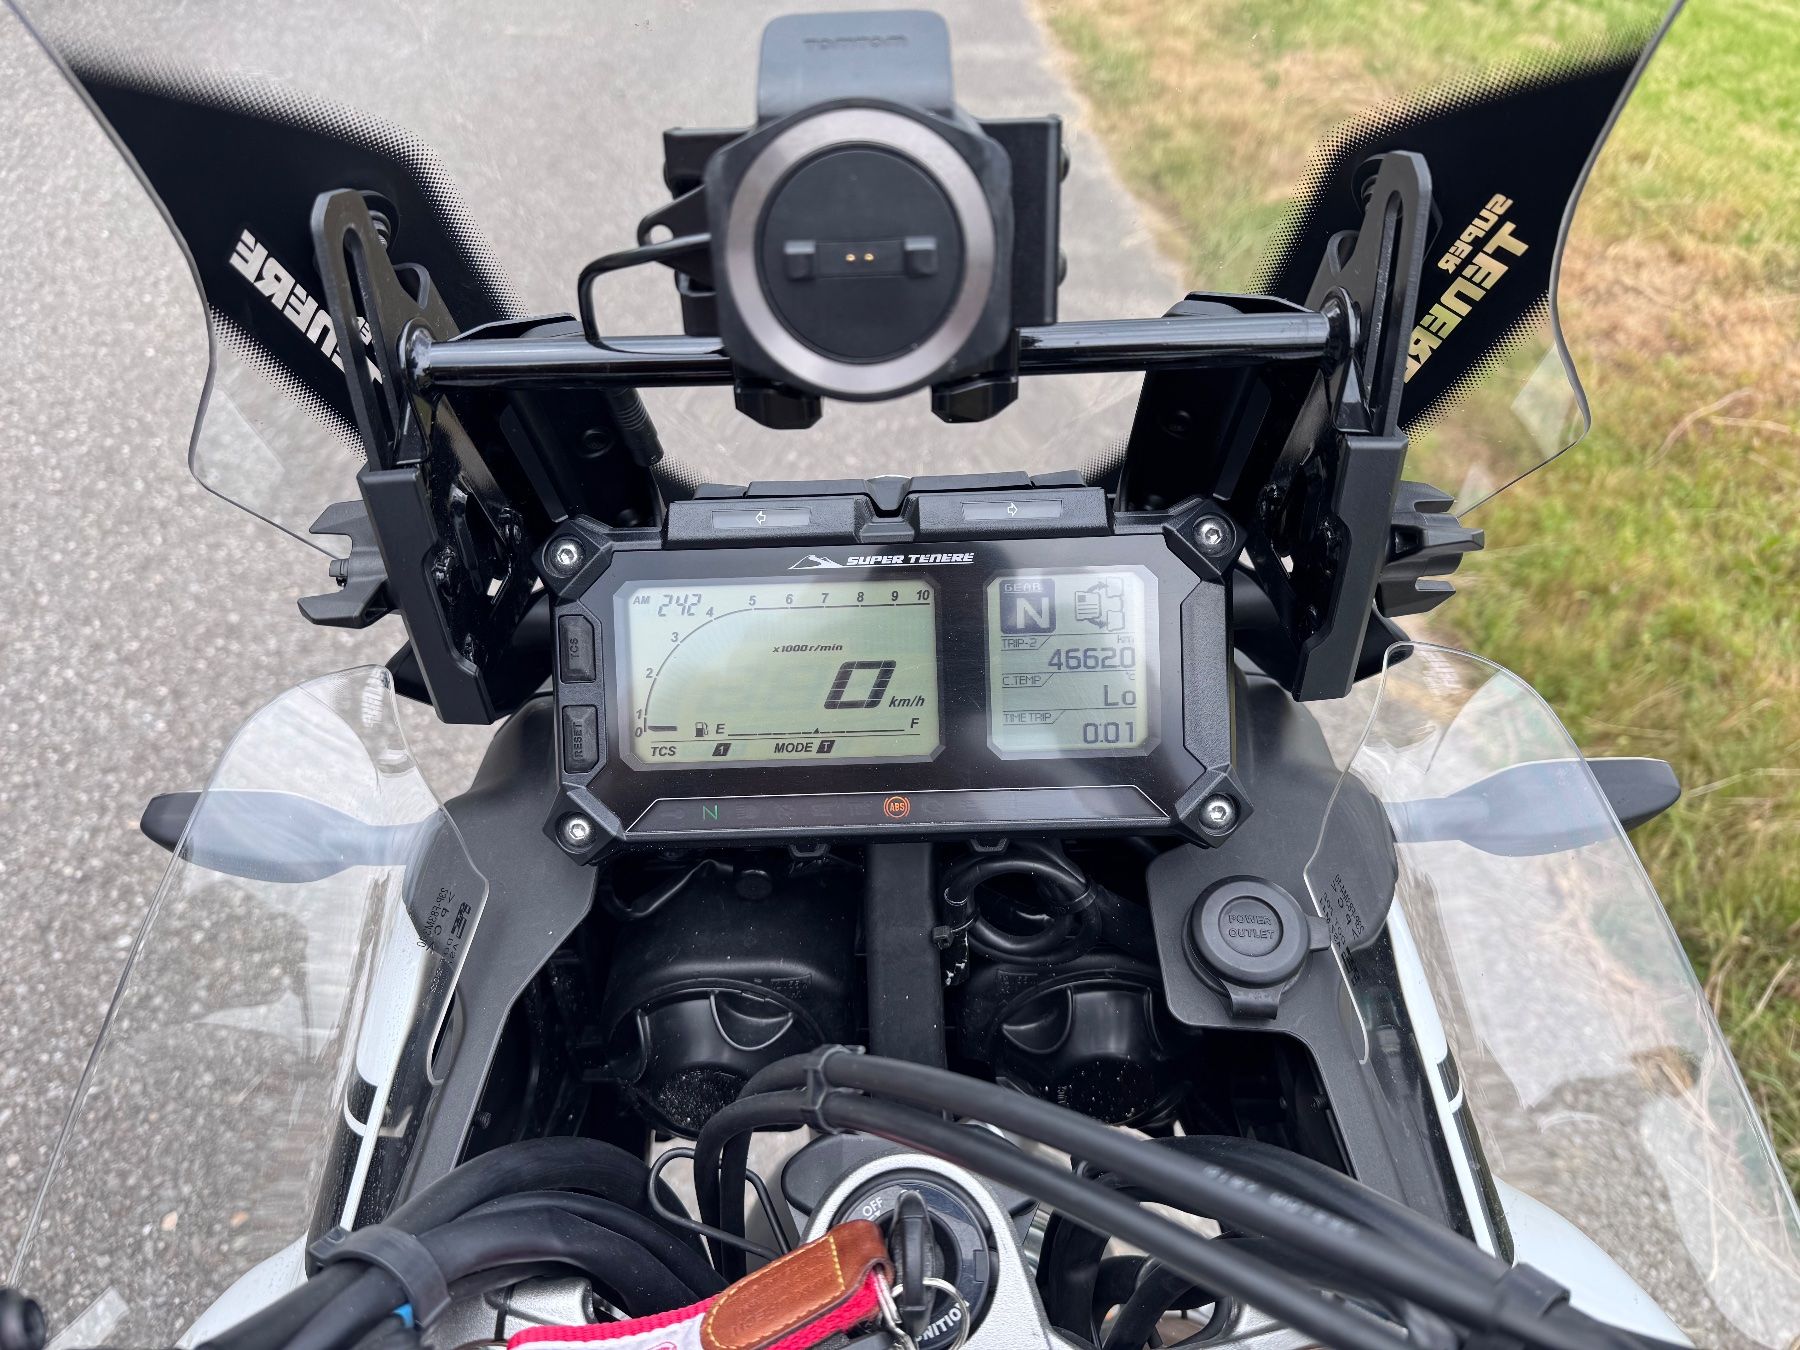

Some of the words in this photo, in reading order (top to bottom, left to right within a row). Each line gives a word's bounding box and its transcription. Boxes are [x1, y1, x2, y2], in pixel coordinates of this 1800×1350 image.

[847, 555, 905, 566] SUPER
[908, 552, 975, 564] TENERE
[1004, 583, 1042, 592] GEAR
[633, 595, 650, 605] AM
[749, 595, 756, 606] 5
[785, 593, 793, 604] 6
[821, 592, 829, 603] 7
[856, 591, 865, 603] 8
[891, 590, 899, 601] 9
[917, 588, 930, 601] 10
[706, 606, 714, 617] 4
[1016, 597, 1049, 629] N
[671, 631, 679, 643] 3
[1002, 637, 1037, 649] TRIP-2
[570, 637, 580, 659] TCS
[1048, 647, 1136, 671] 46620
[646, 667, 653, 679] 2
[824, 660, 896, 709] 0
[889, 695, 925, 709] km/h
[1103, 684, 1136, 706] Lo
[636, 709, 642, 720] 1
[716, 723, 725, 734] E
[910, 717, 919, 728] F
[635, 727, 643, 738] 0
[573, 721, 583, 758] RESET
[651, 745, 677, 757] TCS
[774, 742, 813, 753] MODE
[703, 804, 718, 821] N
[888, 801, 905, 813] ABS
[1228, 914, 1272, 925] POWER
[1228, 928, 1275, 940] OUTLET
[862, 1197, 884, 1217] OFF
[915, 1300, 970, 1342] NITIO
